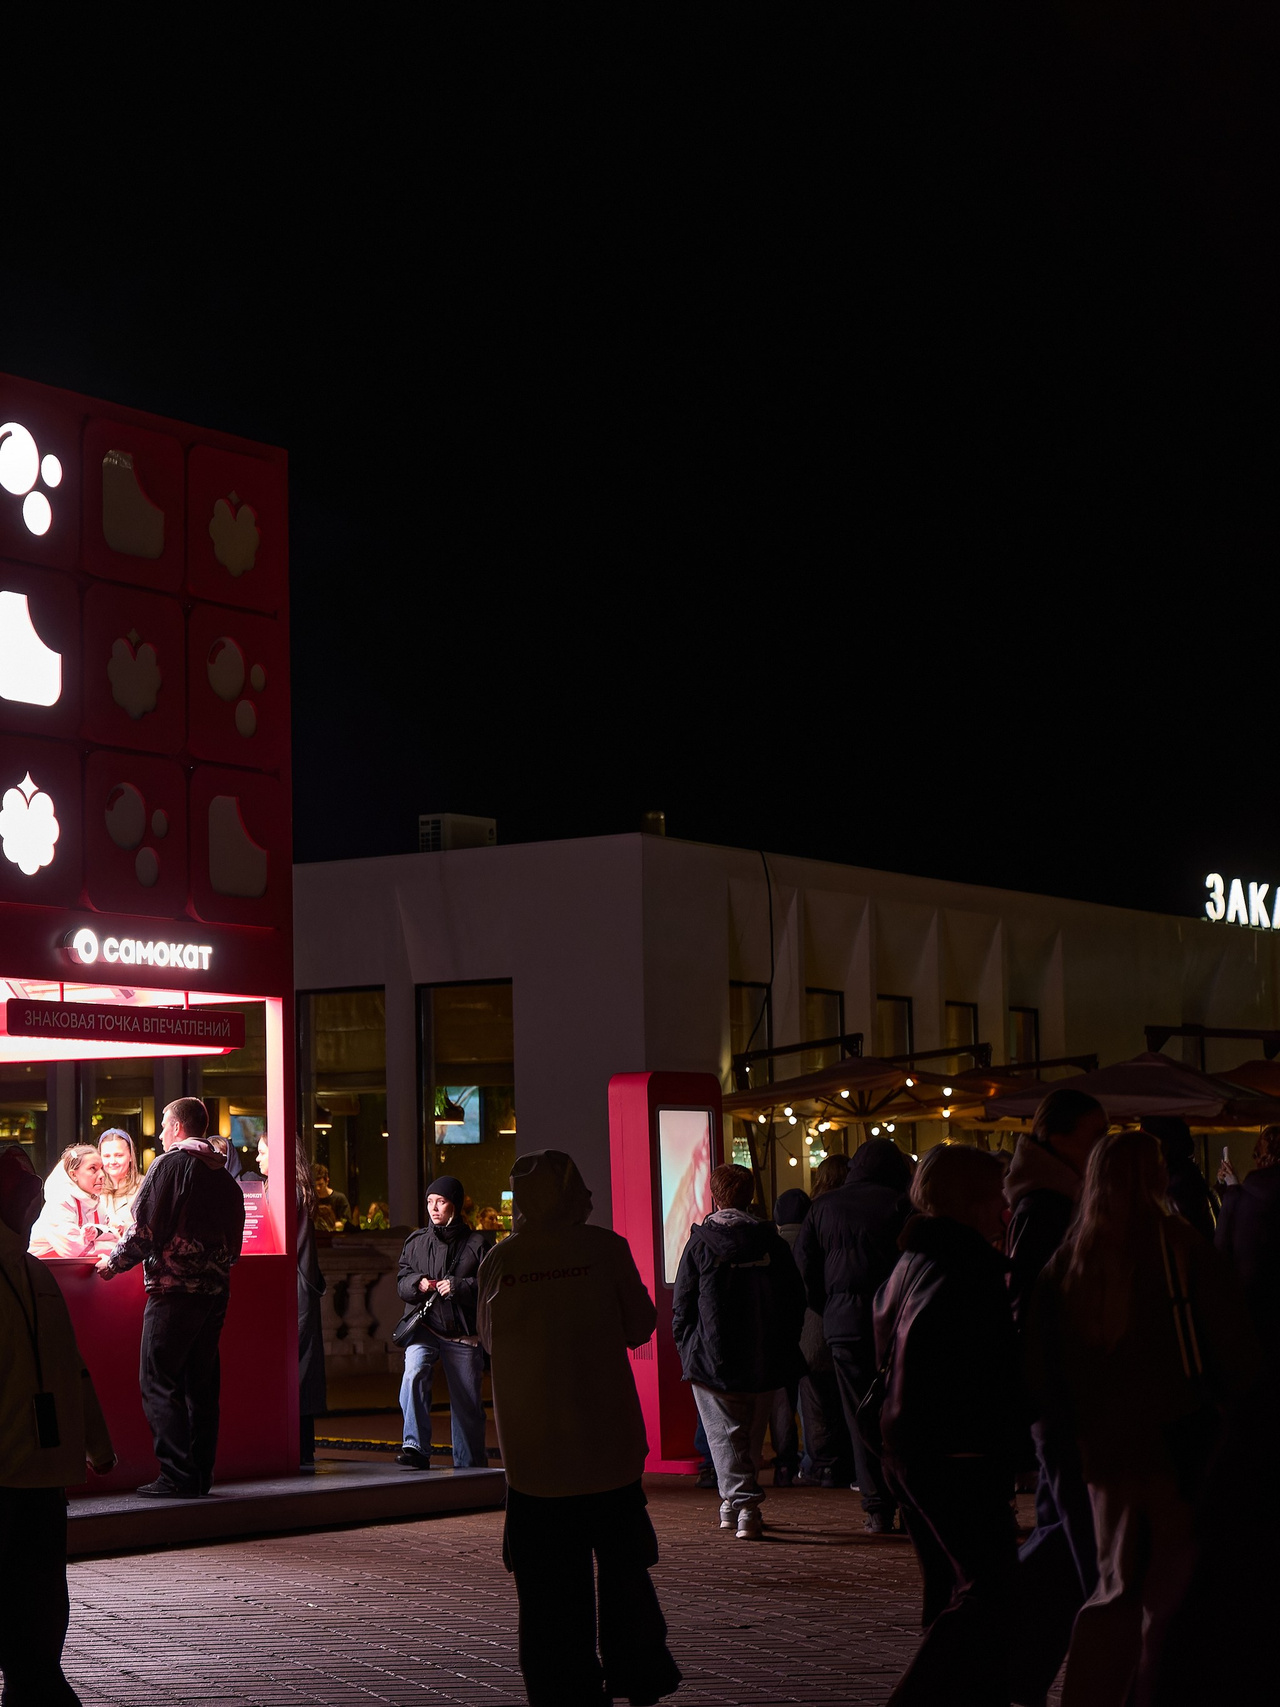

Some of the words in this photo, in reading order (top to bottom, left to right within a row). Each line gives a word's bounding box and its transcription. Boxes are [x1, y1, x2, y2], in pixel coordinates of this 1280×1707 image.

[103, 937, 213, 970] самокат
[24, 1009, 96, 1030] ЗНАКОВАЯ
[98, 1013, 141, 1032] ТОЧКА
[143, 1017, 231, 1038] ВПЕЧАТЛЕНИЙ
[519, 1266, 591, 1284] самокат
